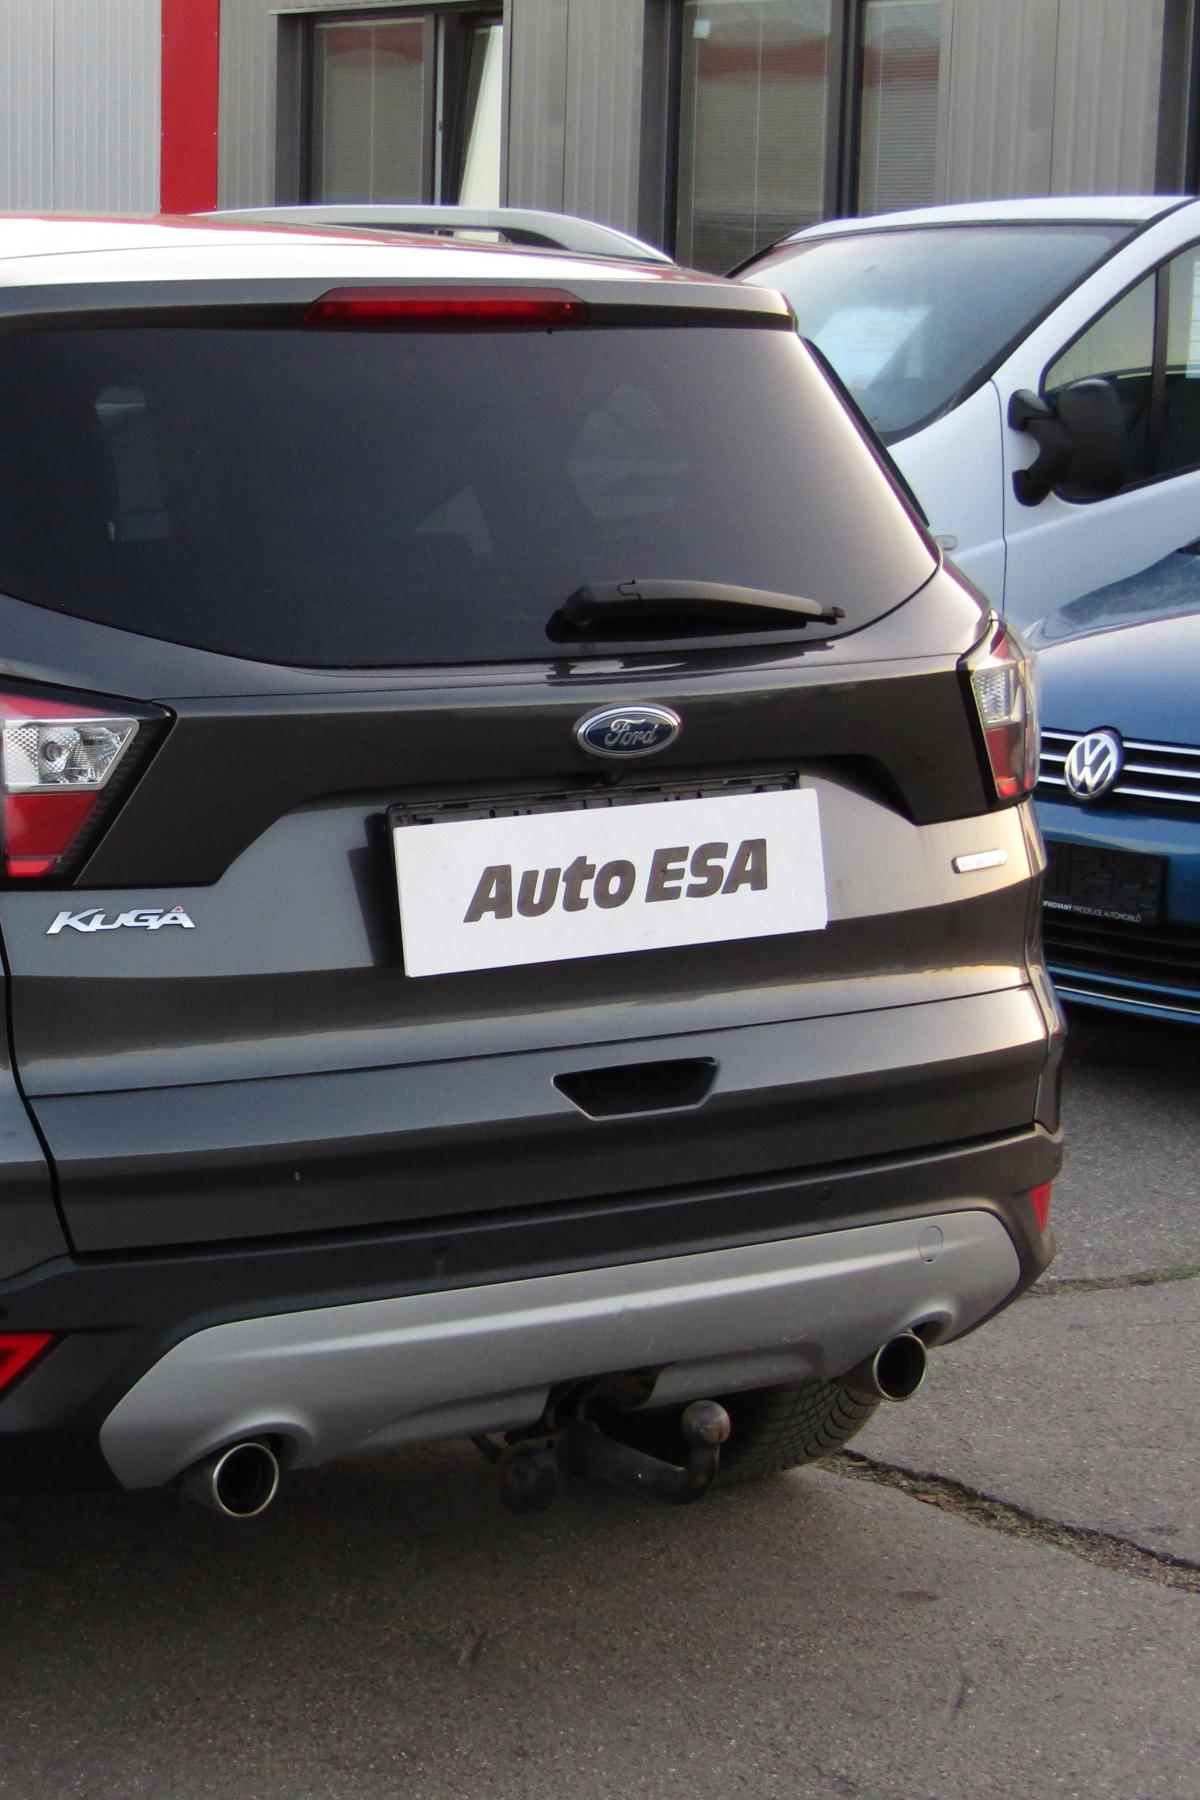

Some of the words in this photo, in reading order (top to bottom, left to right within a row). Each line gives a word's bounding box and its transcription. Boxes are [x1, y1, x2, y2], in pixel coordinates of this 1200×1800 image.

[604, 718, 659, 747] Ford
[463, 856, 636, 923] Auto
[645, 838, 768, 903] ESA
[46, 905, 196, 934] KUGA
